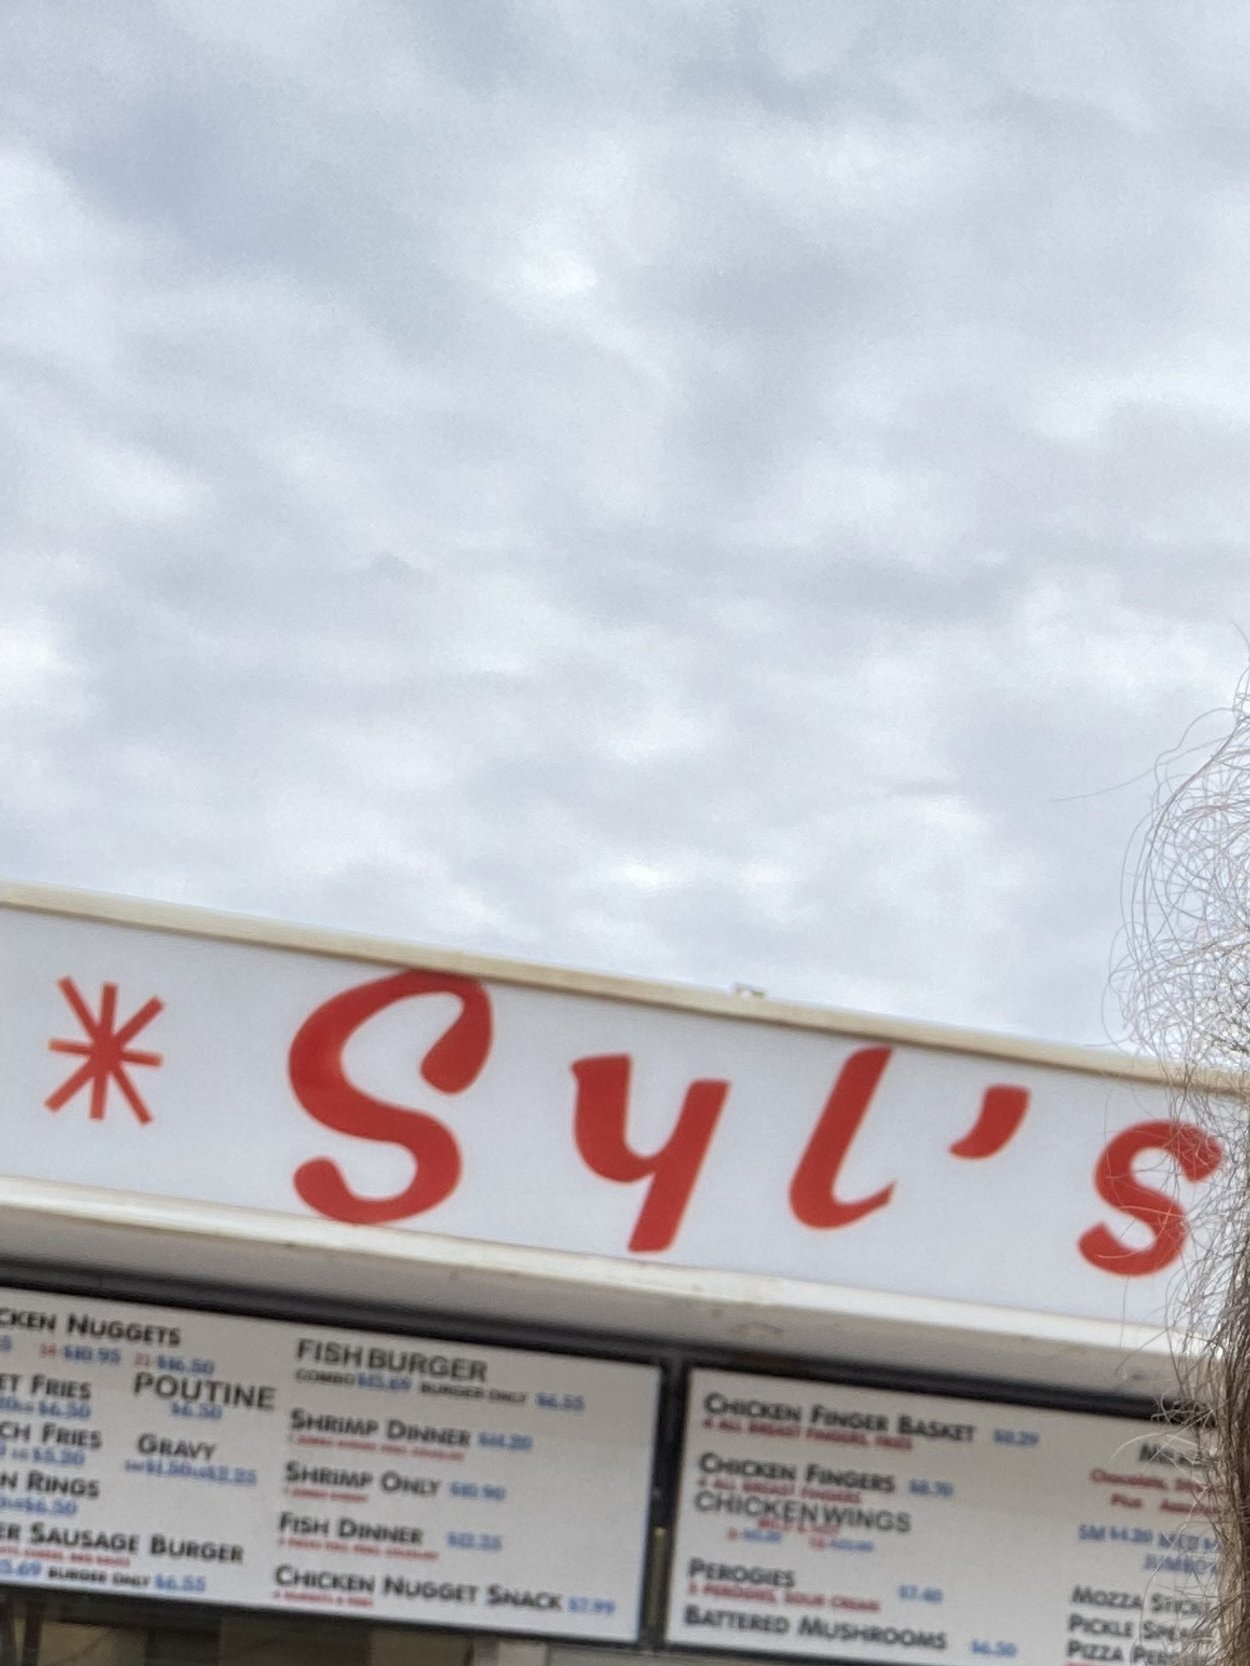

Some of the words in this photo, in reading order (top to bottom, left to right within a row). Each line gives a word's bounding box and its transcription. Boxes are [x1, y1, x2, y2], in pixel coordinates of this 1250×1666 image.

[286, 966, 1226, 1277] Syl's
[66, 1312, 181, 1348] NUGGETS
[31, 1373, 91, 1400] FRIES
[133, 1370, 276, 1411] POUTINE
[290, 1407, 379, 1436] SHRIMP
[386, 1419, 471, 1449] DINNER
[704, 1391, 802, 1422] CHICKEN
[810, 1403, 888, 1432] FINGER
[897, 1412, 977, 1443] BASKET
[41, 1422, 102, 1450] FRIES
[137, 1432, 216, 1460] GRAVY
[27, 1469, 100, 1500] RINGS
[285, 1460, 373, 1488] SHRIMP
[381, 1470, 442, 1497] ONLY
[699, 1451, 797, 1481] CHICKEN
[804, 1463, 895, 1495] FINGERS
[30, 1522, 140, 1554] SAUSAGE
[150, 1532, 244, 1563] BURGER
[279, 1511, 330, 1536] FISH
[337, 1516, 424, 1546] DINNER
[274, 1564, 376, 1595] CHICKEN
[383, 1573, 478, 1605] NUGGET
[485, 1583, 563, 1613] SNACK
[688, 1556, 796, 1588] PEROGIES
[1072, 1585, 1143, 1610] MOZZA
[684, 1604, 790, 1635] BATTERED
[797, 1614, 948, 1651] MUSHROOMS
[1067, 1612, 1133, 1638] PICKLE
[1066, 1638, 1123, 1662] PIZZA
